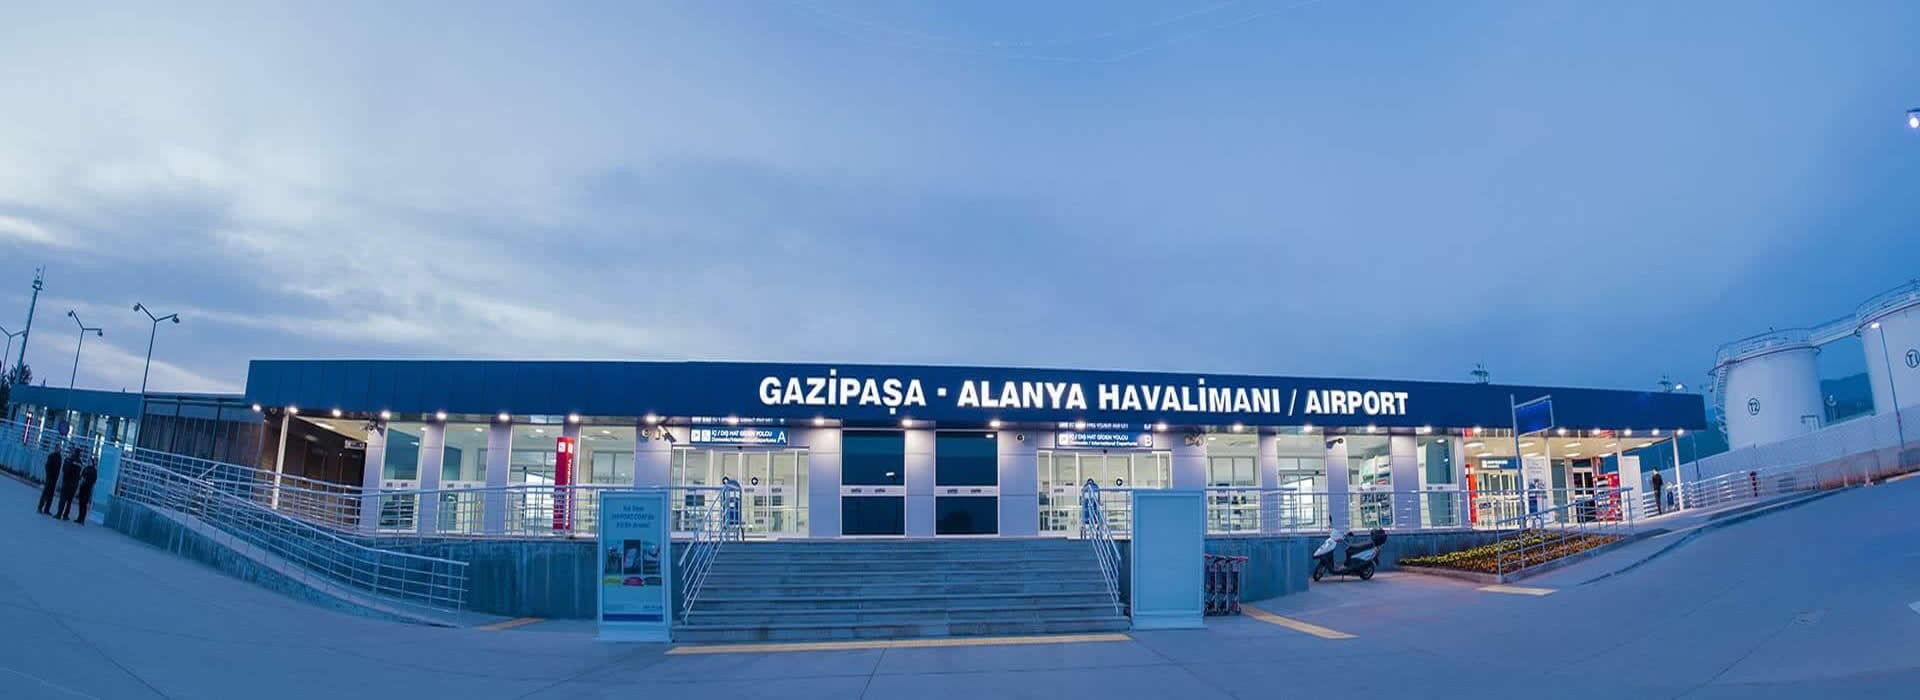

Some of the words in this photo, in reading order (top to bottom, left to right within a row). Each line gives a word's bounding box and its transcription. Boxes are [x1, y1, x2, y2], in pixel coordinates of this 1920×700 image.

[759, 369, 926, 415] GAZİPAŞA
[957, 380, 1087, 410] ALANYA
[1098, 378, 1281, 413] HAVALİMANI
[1304, 389, 1409, 416] AIRPORT
[777, 431, 786, 444] A
[1144, 435, 1153, 447] B
